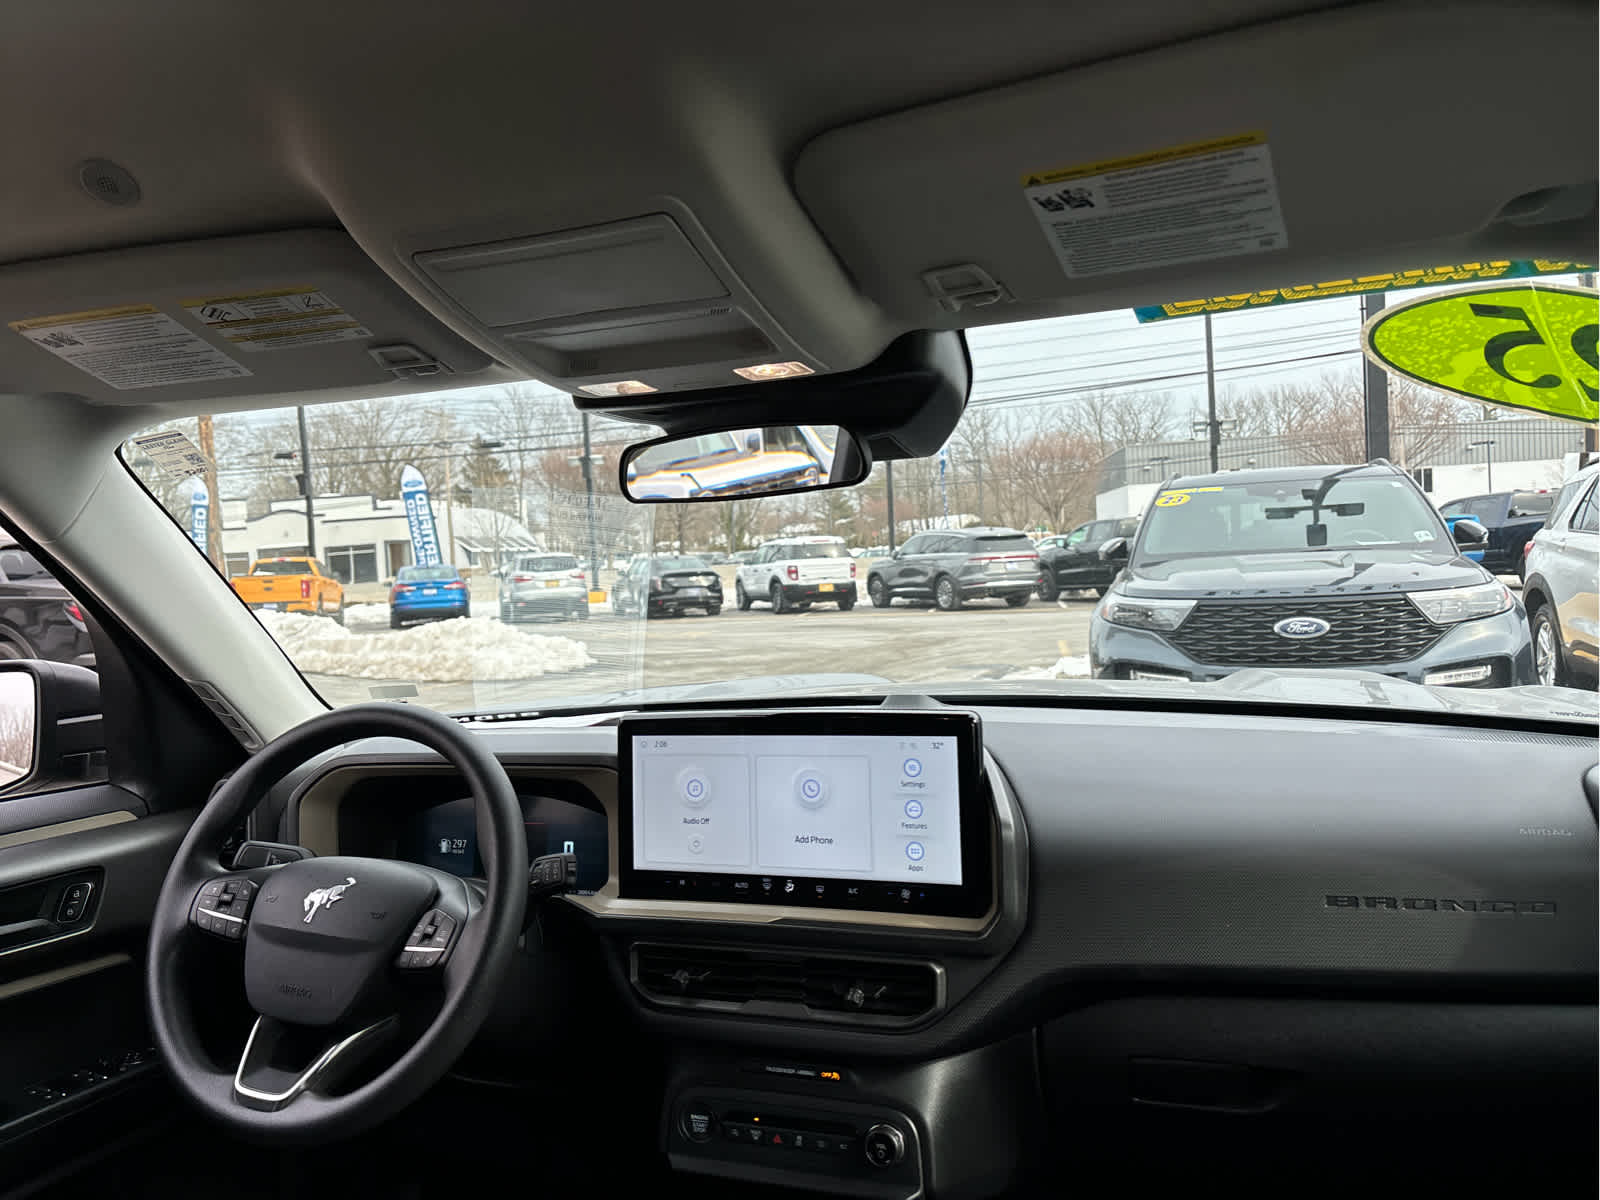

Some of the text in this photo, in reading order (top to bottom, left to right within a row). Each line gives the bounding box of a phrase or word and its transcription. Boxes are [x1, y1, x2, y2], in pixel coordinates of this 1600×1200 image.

[900, 780, 926, 789] Settings
[682, 816, 700, 825] Audio
[901, 821, 928, 831] Features
[452, 838, 467, 848] 297
[794, 835, 834, 845] Add Phone
[907, 864, 924, 873] Apps
[1324, 894, 1557, 915] BRONCO
